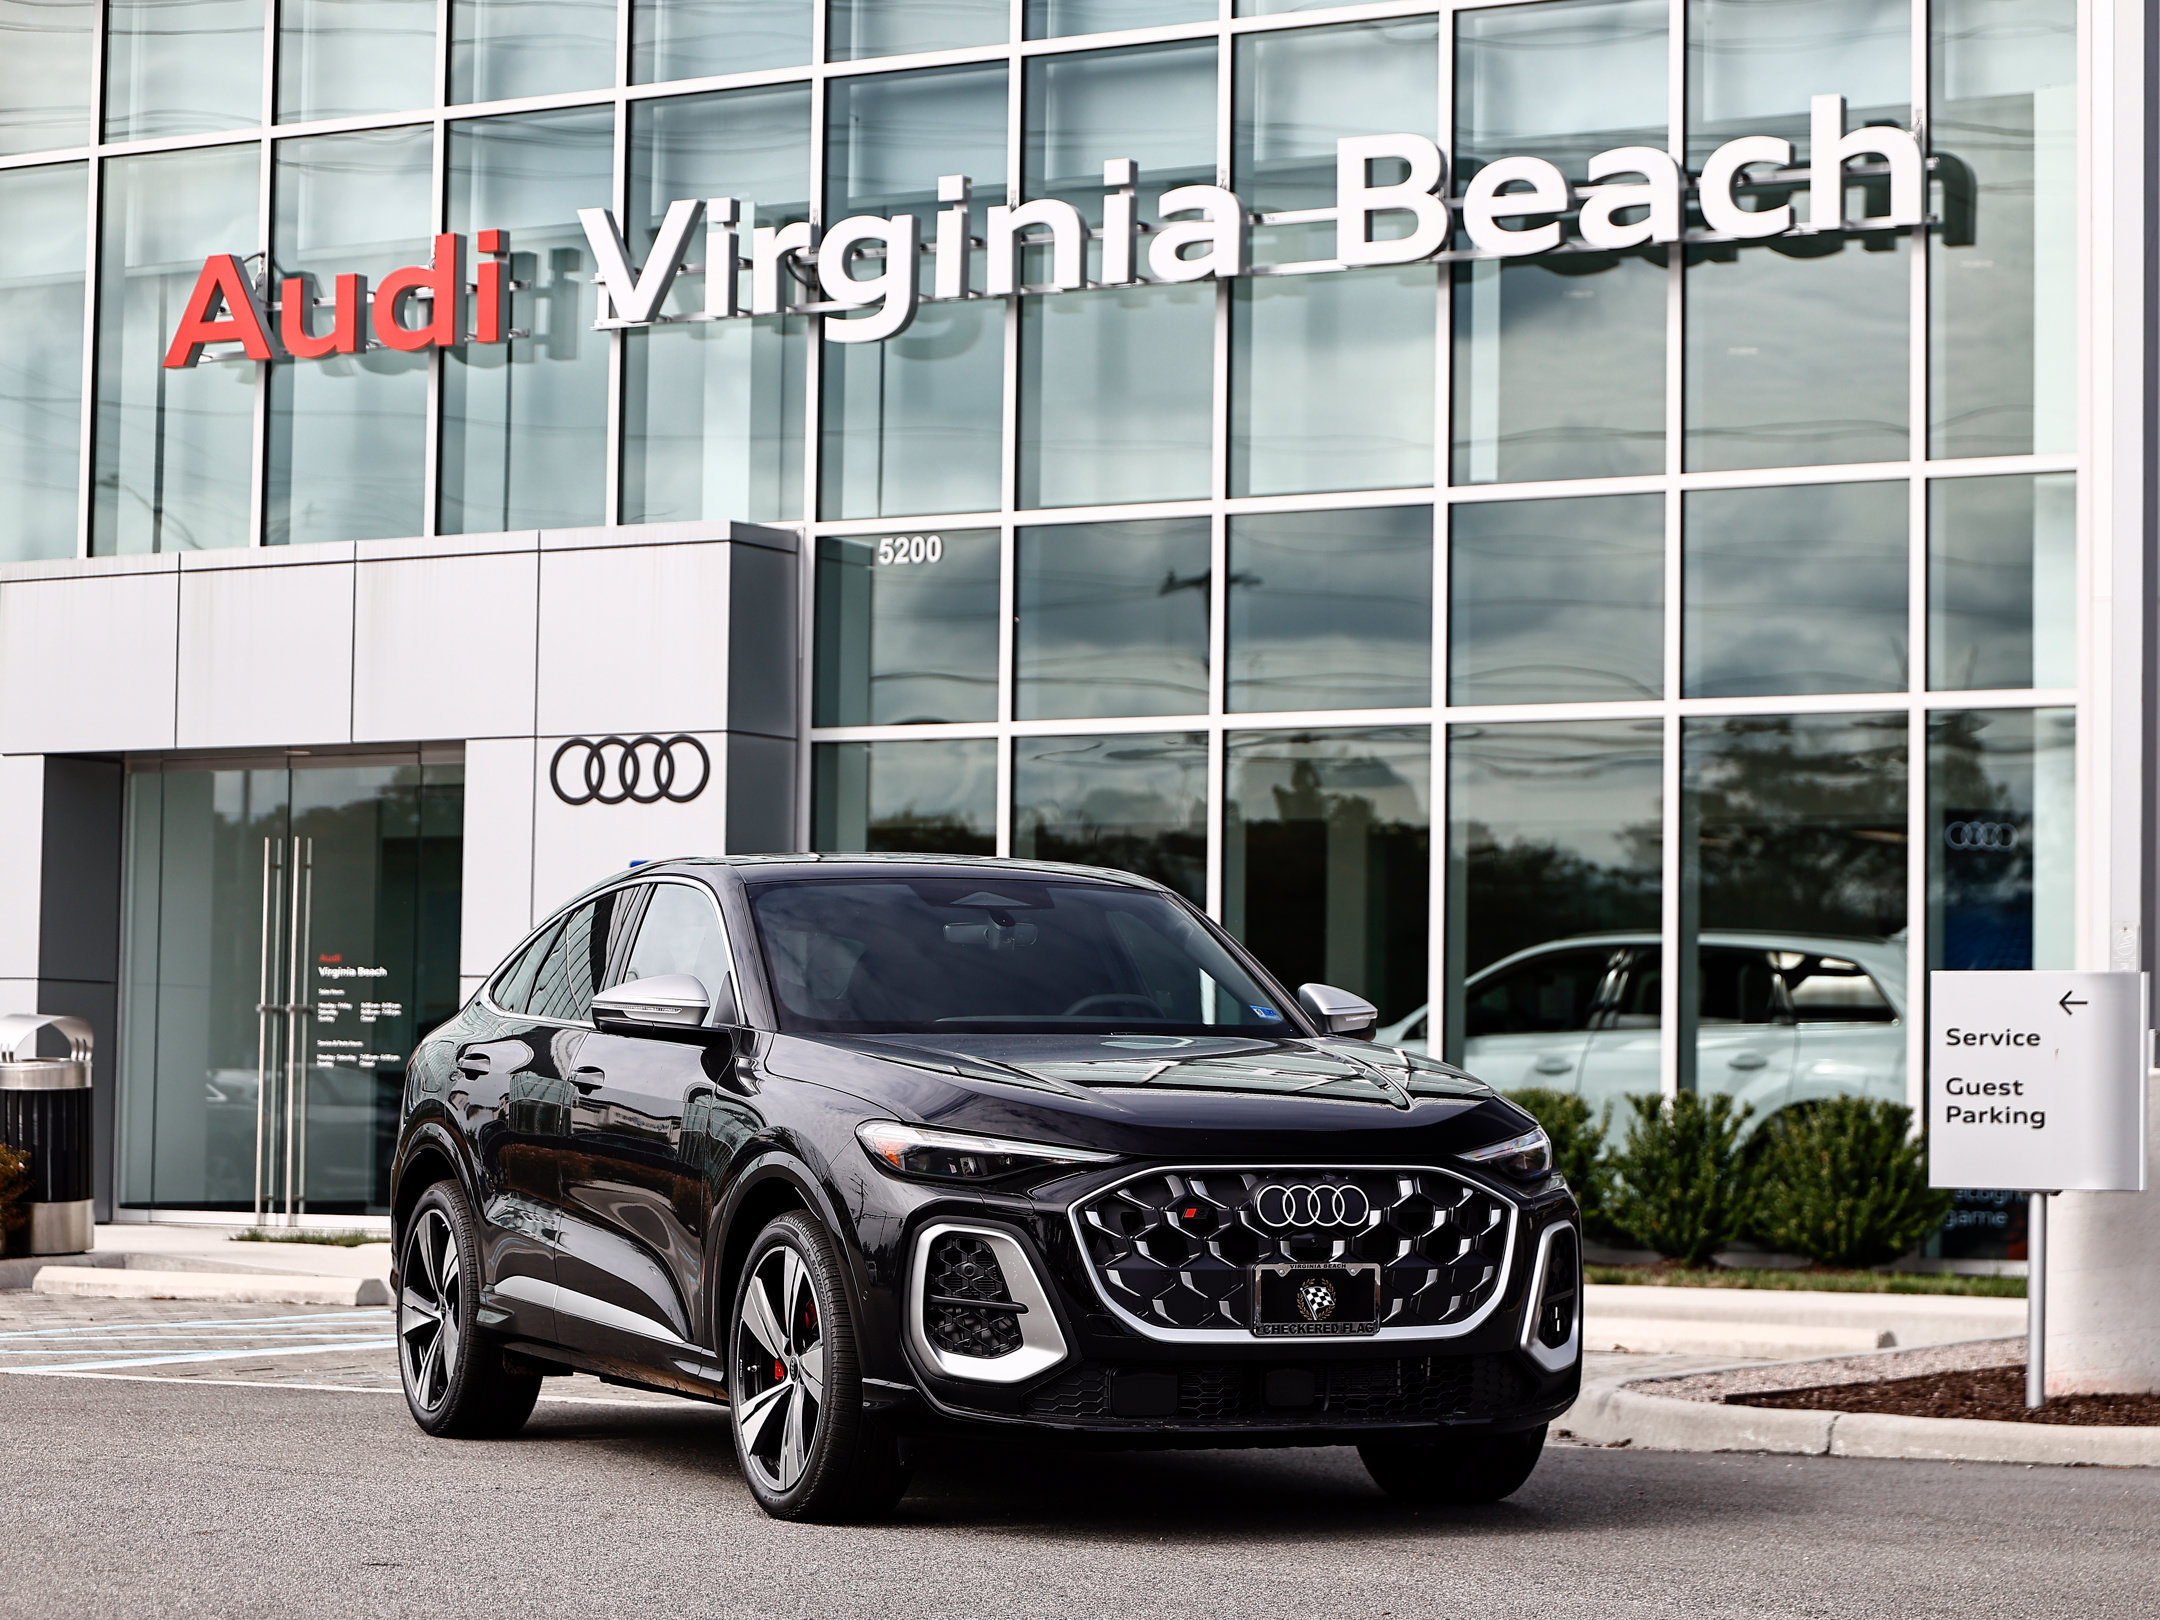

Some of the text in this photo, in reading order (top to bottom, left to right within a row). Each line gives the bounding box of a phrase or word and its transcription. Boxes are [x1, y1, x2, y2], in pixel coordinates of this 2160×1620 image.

[163, 94, 1925, 369] Audi Virginia Beach
[878, 535, 943, 565] 5200
[318, 966, 387, 979] Virginia Beach
[1946, 1028, 2041, 1047] Service
[1946, 1077, 2024, 1096] Guest
[1946, 1106, 2046, 1129] Parking
[1944, 1209, 2008, 1231] game
[1263, 1322, 1374, 1335] CHECKERED FLAG
